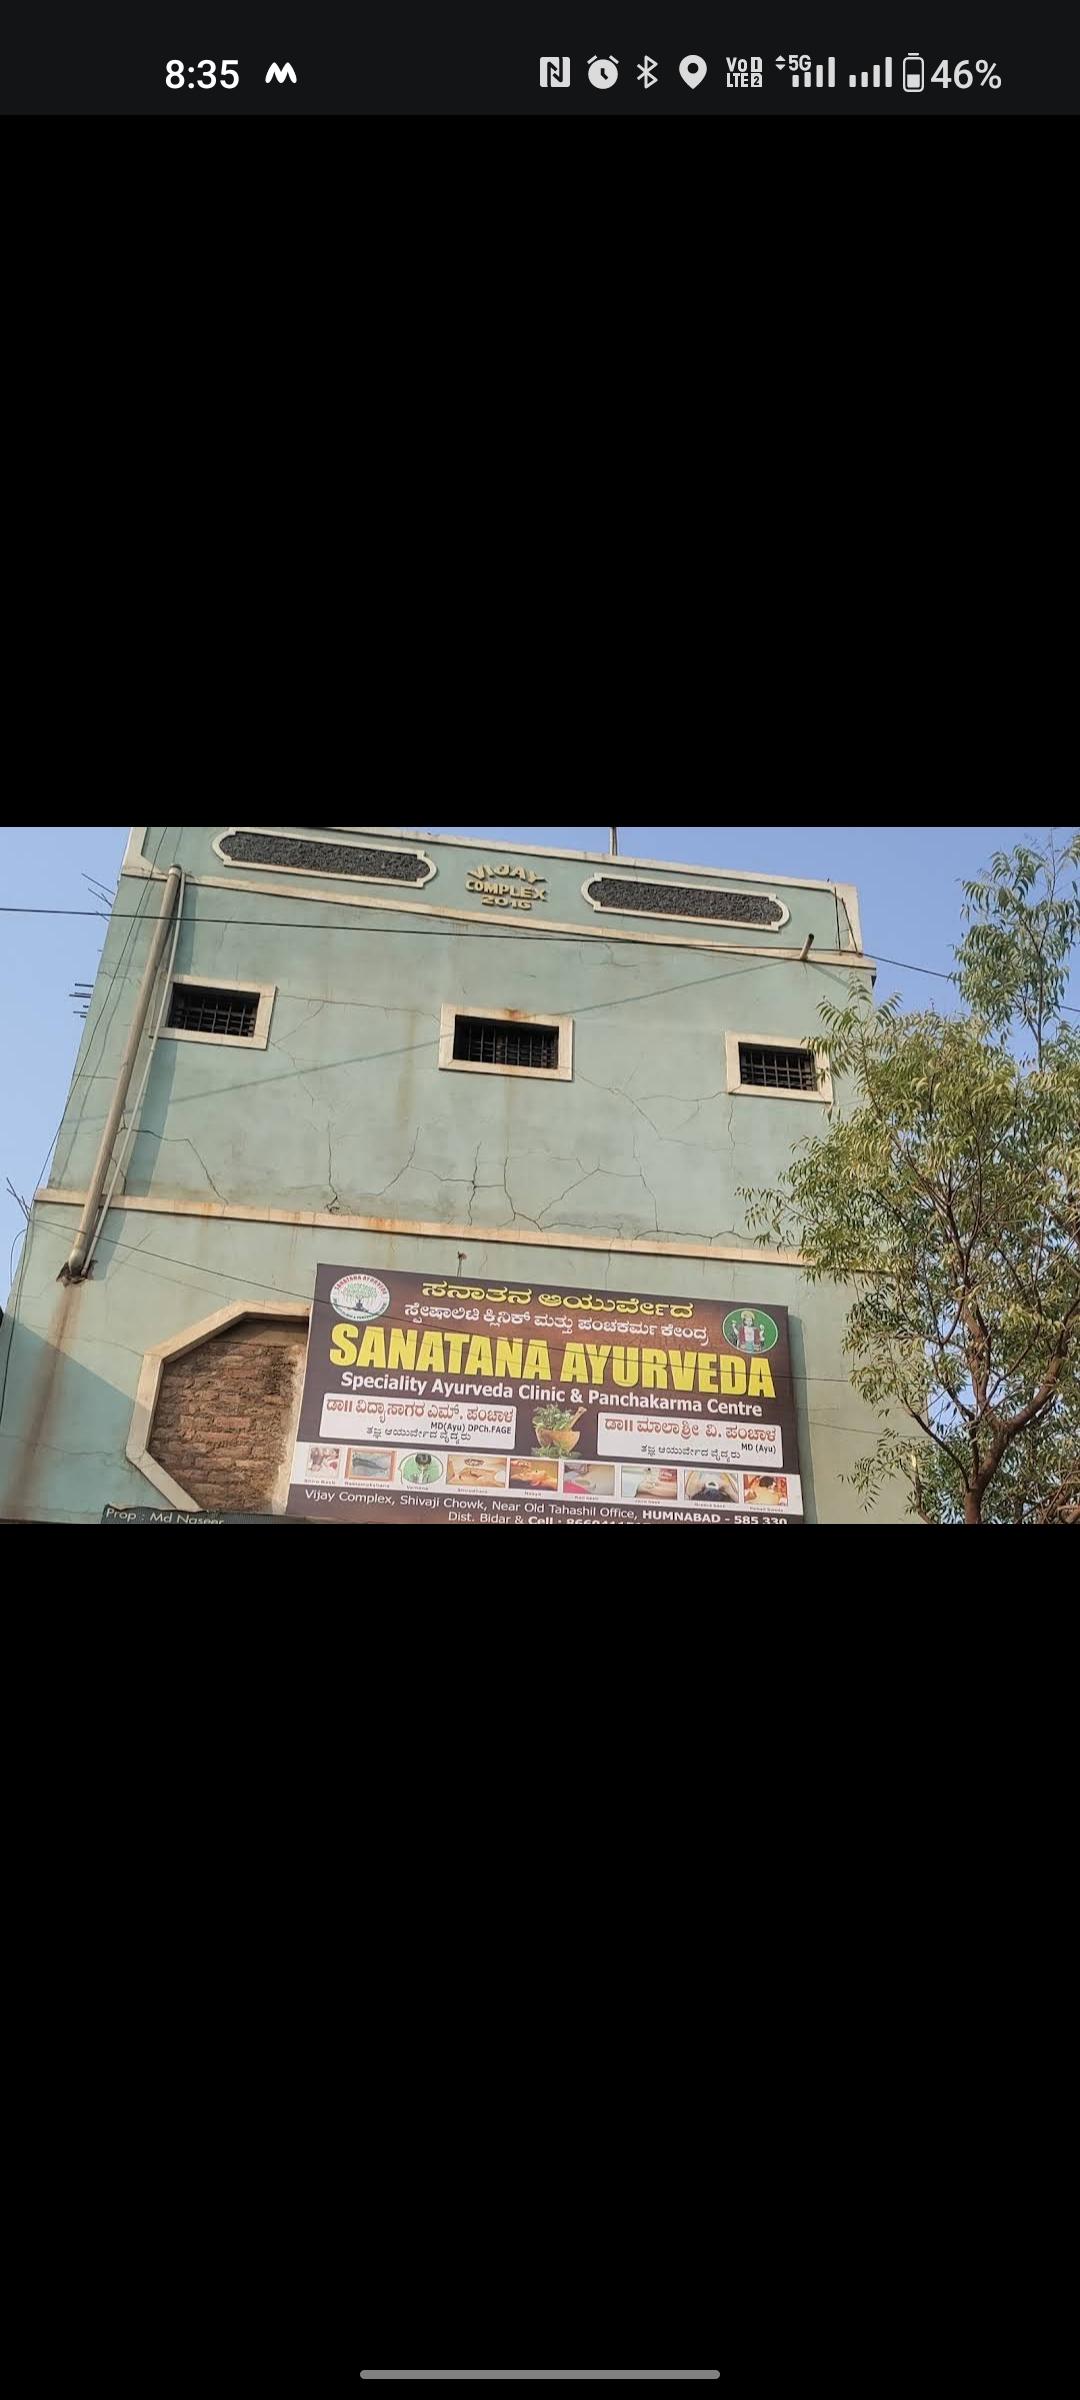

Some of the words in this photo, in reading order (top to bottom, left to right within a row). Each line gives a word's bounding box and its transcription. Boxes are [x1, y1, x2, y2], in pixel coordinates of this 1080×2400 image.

[467, 864, 547, 884] VIJAY
[465, 880, 547, 901] COMPLEX
[421, 1280, 532, 1305] ಸನಾತನ
[538, 1292, 694, 1319] ಆಯುರ್ವೇದ
[534, 1314, 574, 1334] ಮತ್ತು
[578, 1318, 657, 1336] ಪಂಚಕರ್ಮ
[661, 1323, 709, 1346] ಕೇಂದ್ರ
[329, 1323, 552, 1380] SANATANA
[560, 1341, 776, 1398] AYURVEDA
[341, 1372, 427, 1396] Speciality
[431, 1379, 513, 1402] Ayurveda
[518, 1385, 565, 1403] Clinic
[570, 1389, 583, 1403] &
[588, 1390, 702, 1412] Panchakarma
[707, 1399, 763, 1417] Centre
[741, 1442, 753, 1451] MD
[756, 1443, 777, 1454] (Ayu)
[106, 1508, 137, 1523] Prop
[150, 1512, 173, 1523] Md
[305, 1489, 335, 1502] Vijay
[339, 1491, 395, 1506] Complex,
[400, 1495, 440, 1509] Shivaji
[443, 1498, 488, 1511] Chowk,
[492, 1501, 521, 1511] Near
[524, 1503, 545, 1513] Old
[548, 1504, 596, 1517] Tahashil
[600, 1507, 637, 1520] Office,
[642, 1510, 720, 1523] HUMNABAD
[734, 1515, 759, 1524] 585
[448, 1512, 475, 1523] Dist.
[480, 1513, 511, 1524] Bidar
[514, 1515, 525, 1524] &
[528, 1516, 553, 1524] Cell
